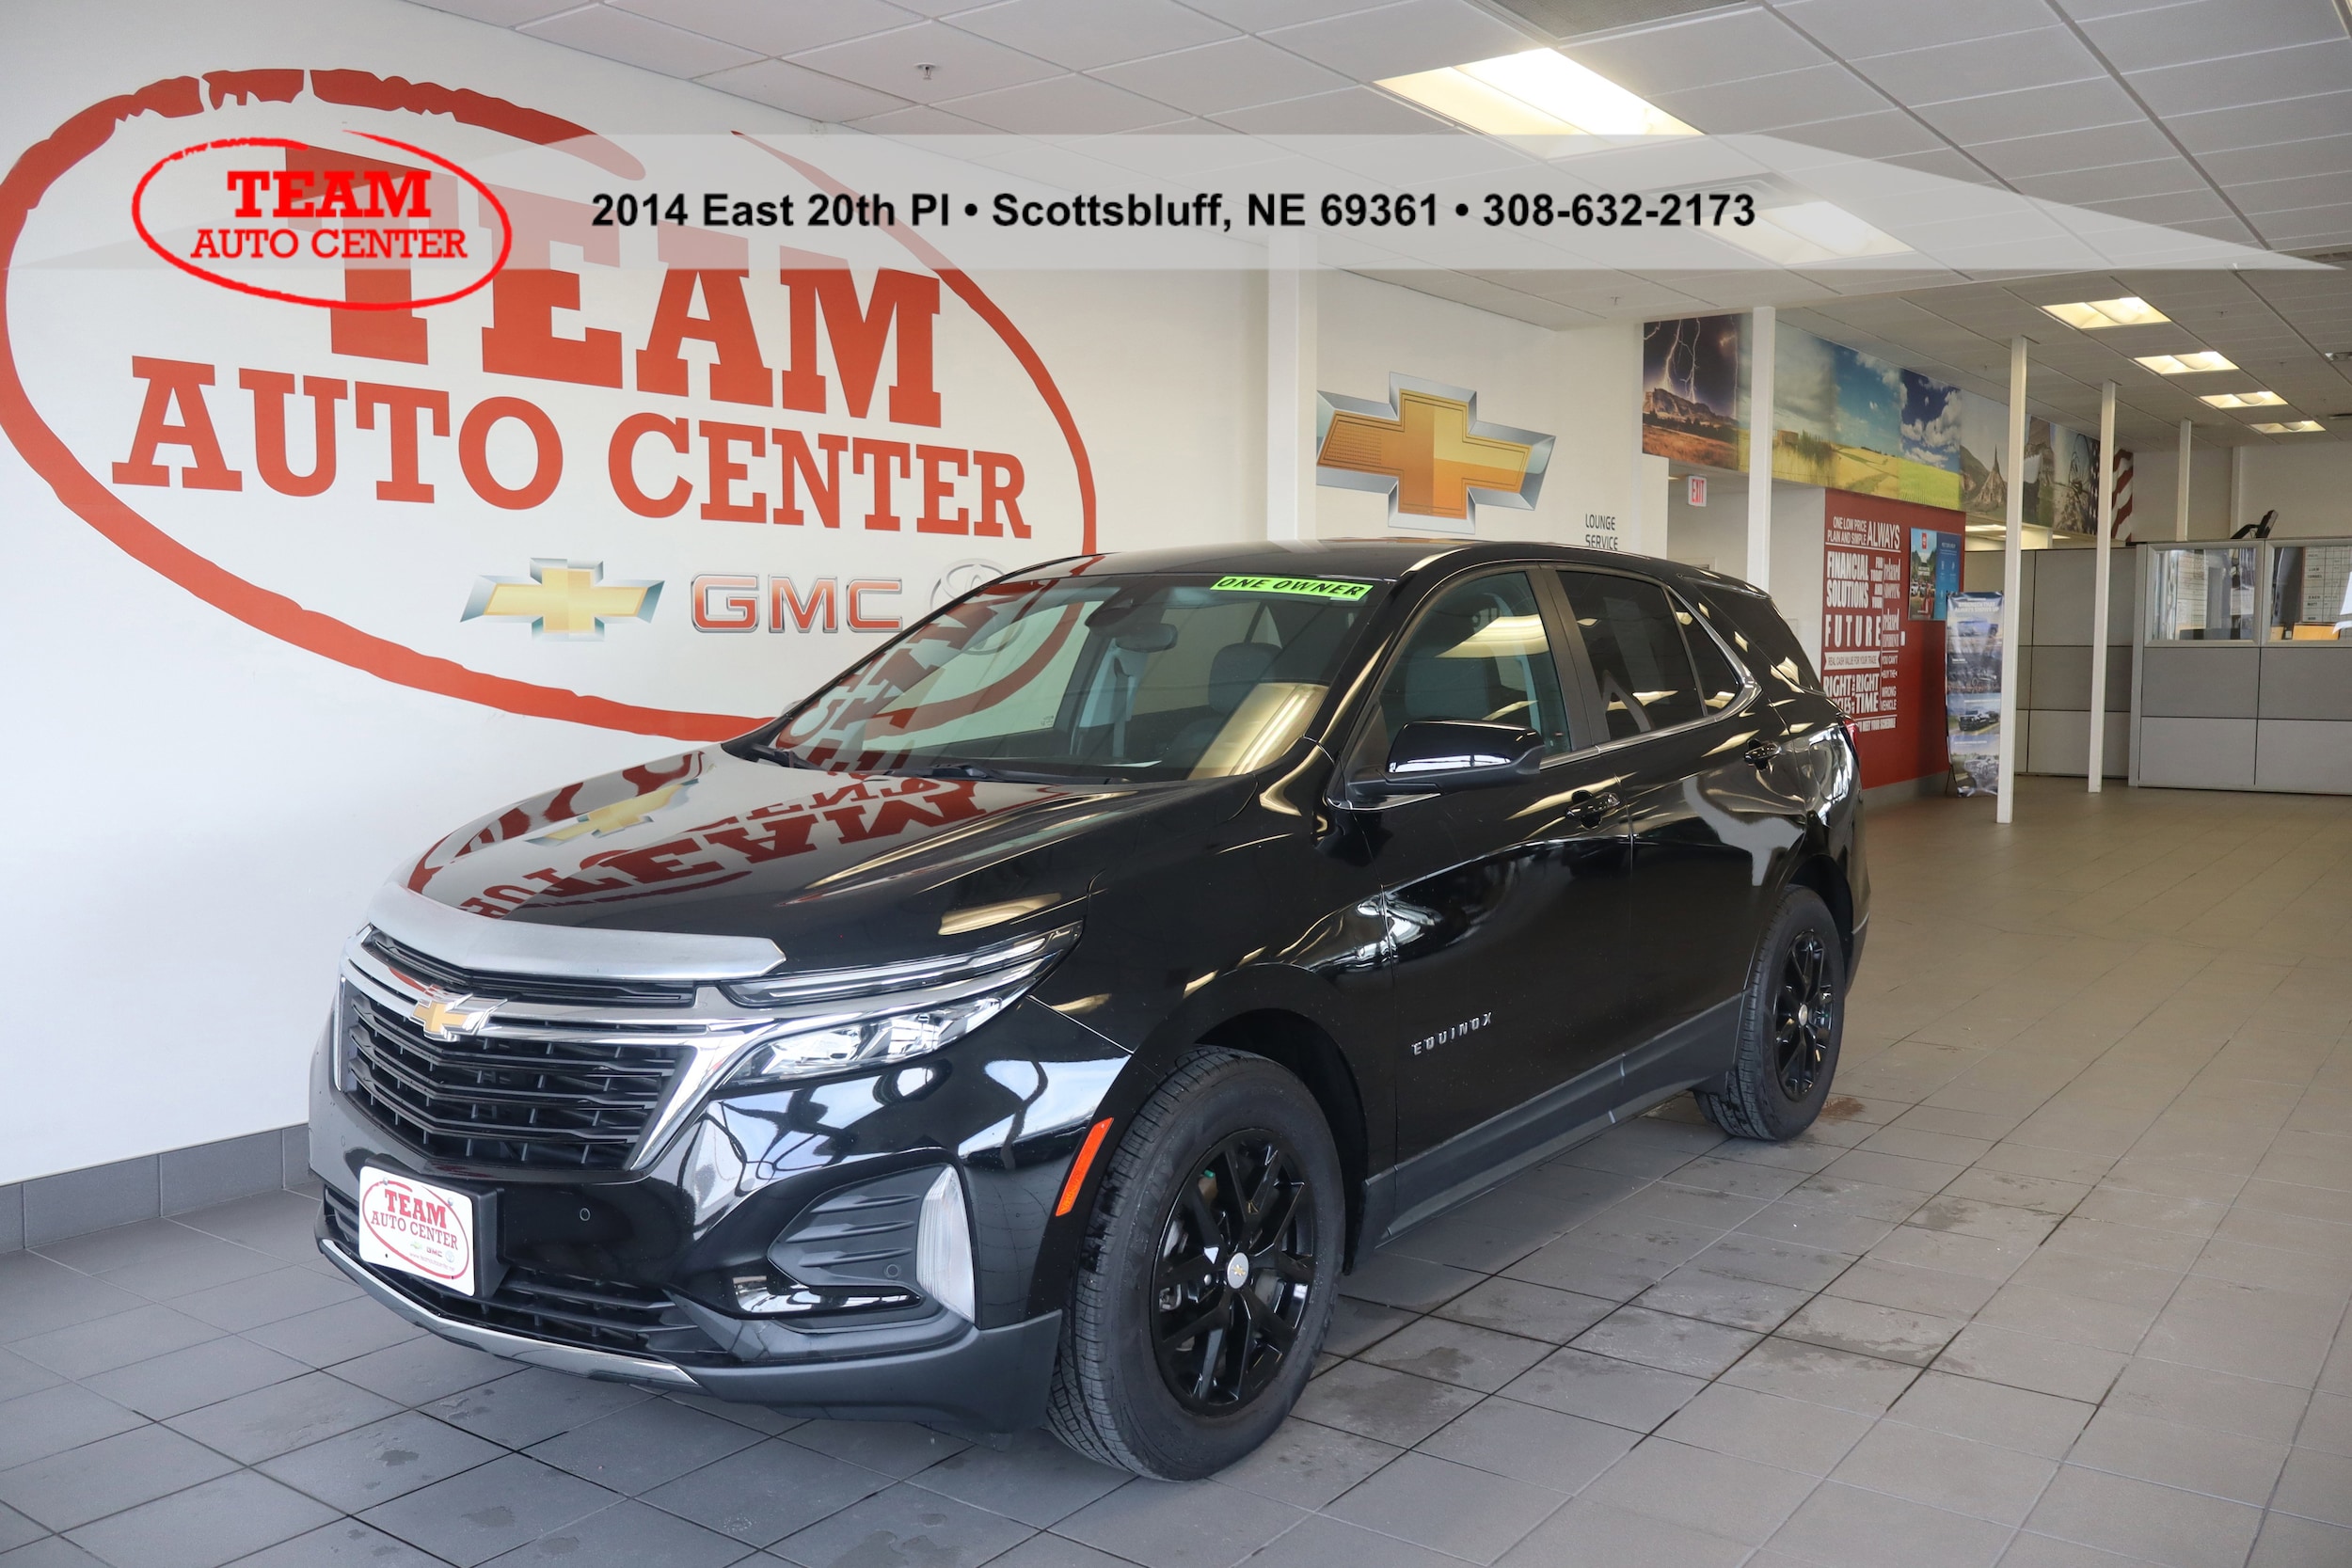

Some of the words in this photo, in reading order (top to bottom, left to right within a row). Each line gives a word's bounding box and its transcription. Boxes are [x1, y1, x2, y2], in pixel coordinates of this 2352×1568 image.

[284, 146, 941, 429] TEAM
[112, 356, 564, 510] AUTO
[608, 412, 1032, 539] CENTER
[1691, 478, 1705, 503] EXIT
[1585, 514, 1615, 531] LOUNGE
[1833, 515, 1843, 529] ONE
[1867, 521, 1900, 549] ALWAYS
[1585, 534, 1618, 551] SERVICE
[1827, 550, 1868, 580] FINANCIAL
[1217, 578, 1271, 588] ONE
[1272, 579, 1366, 596] OWNER
[1826, 578, 1869, 609] SOLUTIONS
[690, 571, 903, 633] GMC
[1825, 614, 1882, 647] FUTURE
[1823, 674, 1851, 697] RIGHT
[1855, 673, 1880, 692] RIGHT
[1855, 691, 1879, 714] TIME
[1411, 1011, 1492, 1056] EQUINOX
[385, 1188, 447, 1229] TEAM
[371, 1210, 406, 1232] AUTO
[409, 1221, 458, 1251] CENTER
